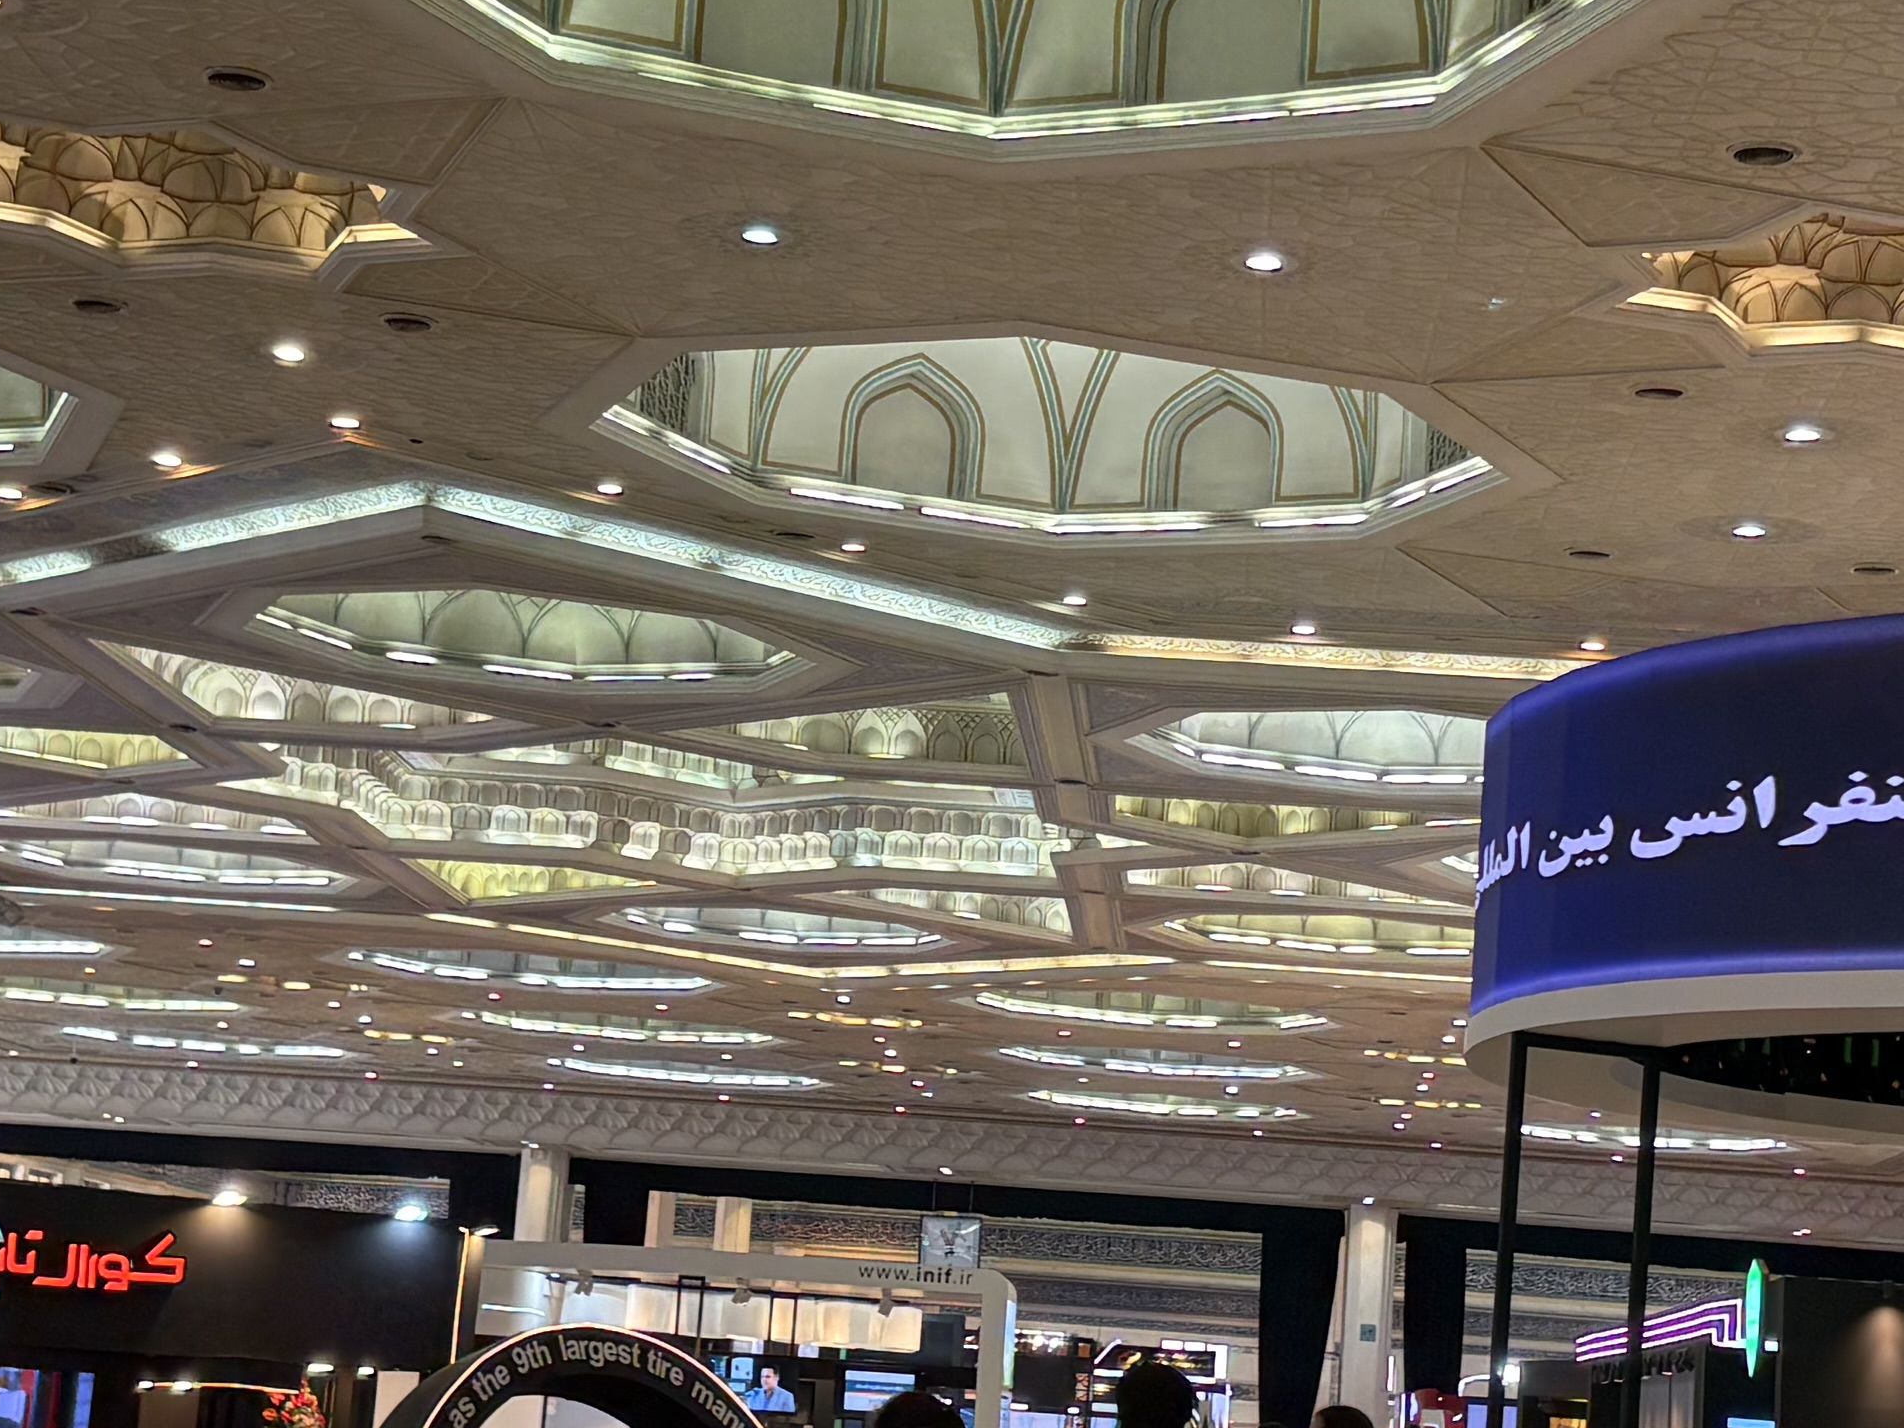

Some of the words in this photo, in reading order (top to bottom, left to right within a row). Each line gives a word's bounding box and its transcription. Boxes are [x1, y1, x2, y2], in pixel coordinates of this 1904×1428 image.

[1538, 815, 1614, 877] بین
[32, 1233, 186, 1291] کورال
[858, 1265, 973, 1285] www.inif.ir
[472, 1365, 511, 1401] the
[511, 1340, 553, 1374] 9th
[559, 1335, 641, 1368] largest
[647, 1349, 684, 1387] tire
